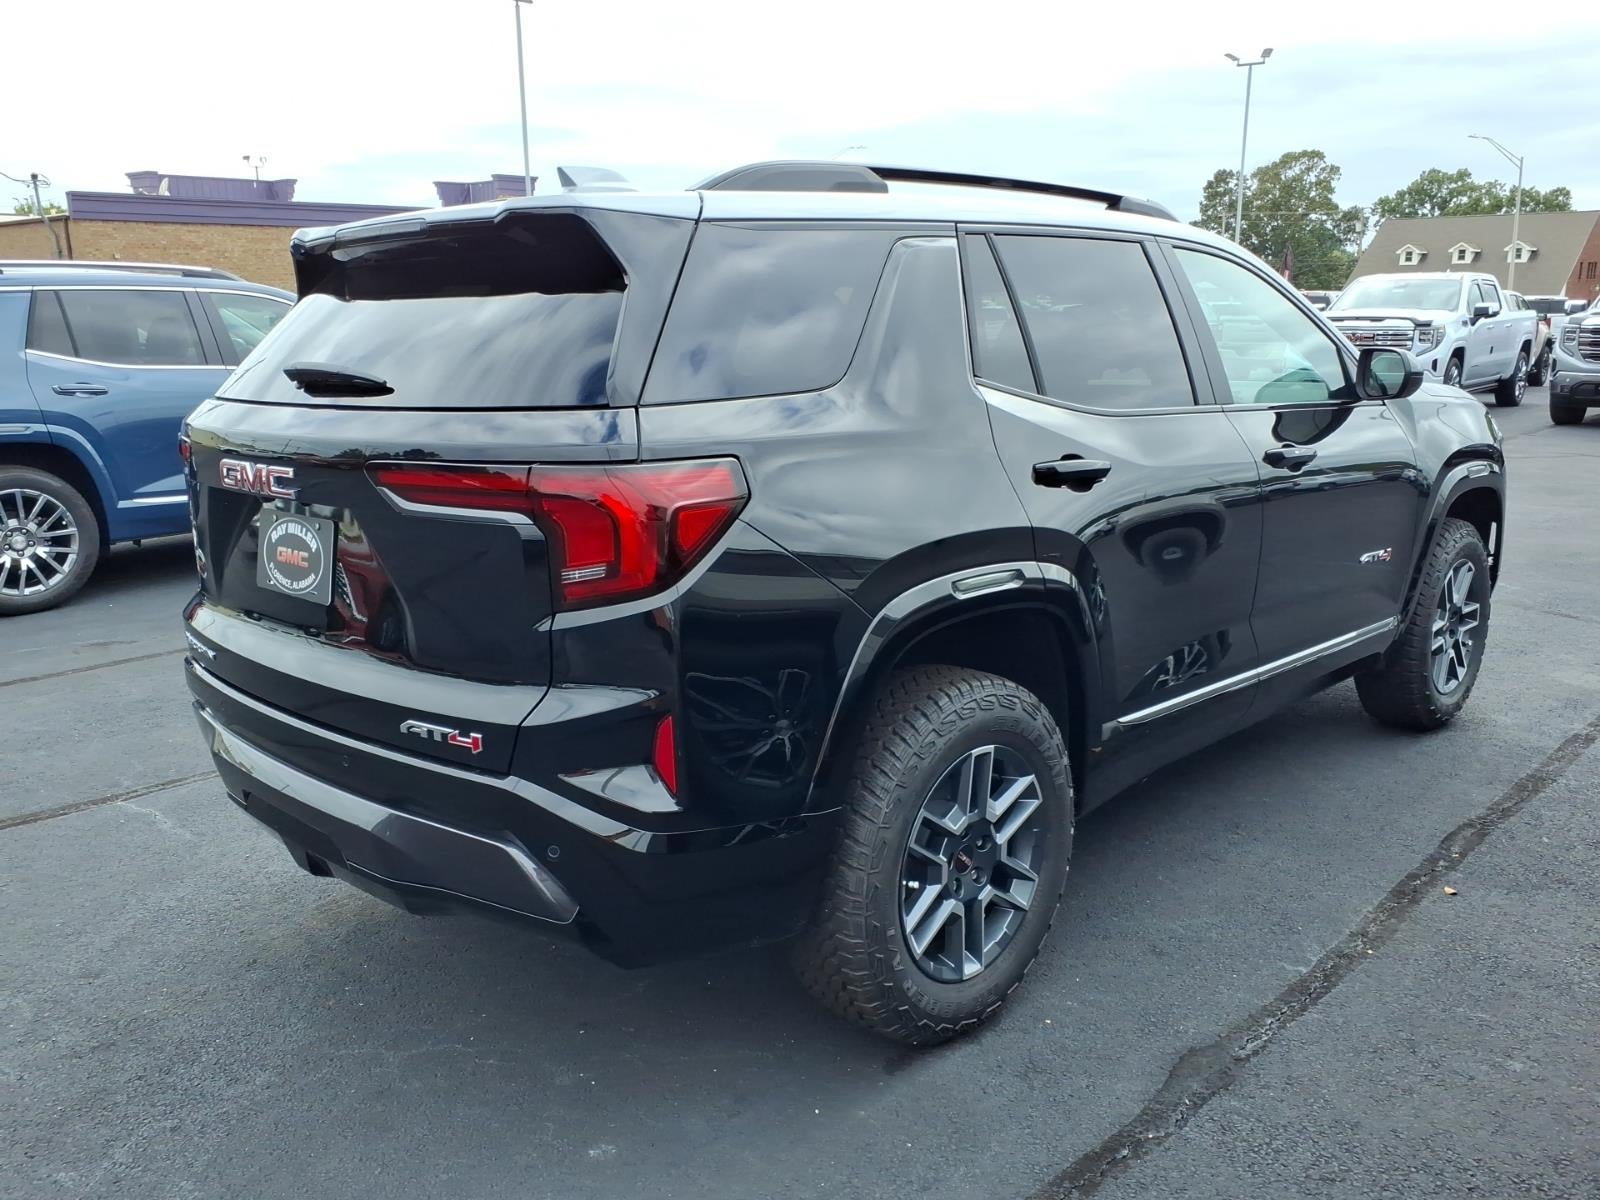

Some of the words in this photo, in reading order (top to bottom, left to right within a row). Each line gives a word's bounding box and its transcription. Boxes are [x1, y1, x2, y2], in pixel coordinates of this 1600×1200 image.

[219, 458, 297, 499] GMC
[270, 522, 287, 543] RAY
[287, 522, 318, 553] MILLER
[276, 546, 309, 568] GMC
[1359, 547, 1392, 564] AT4
[269, 561, 293, 589] FLORENCE,
[292, 572, 316, 589] ALABAMA
[400, 719, 484, 754] AT4
